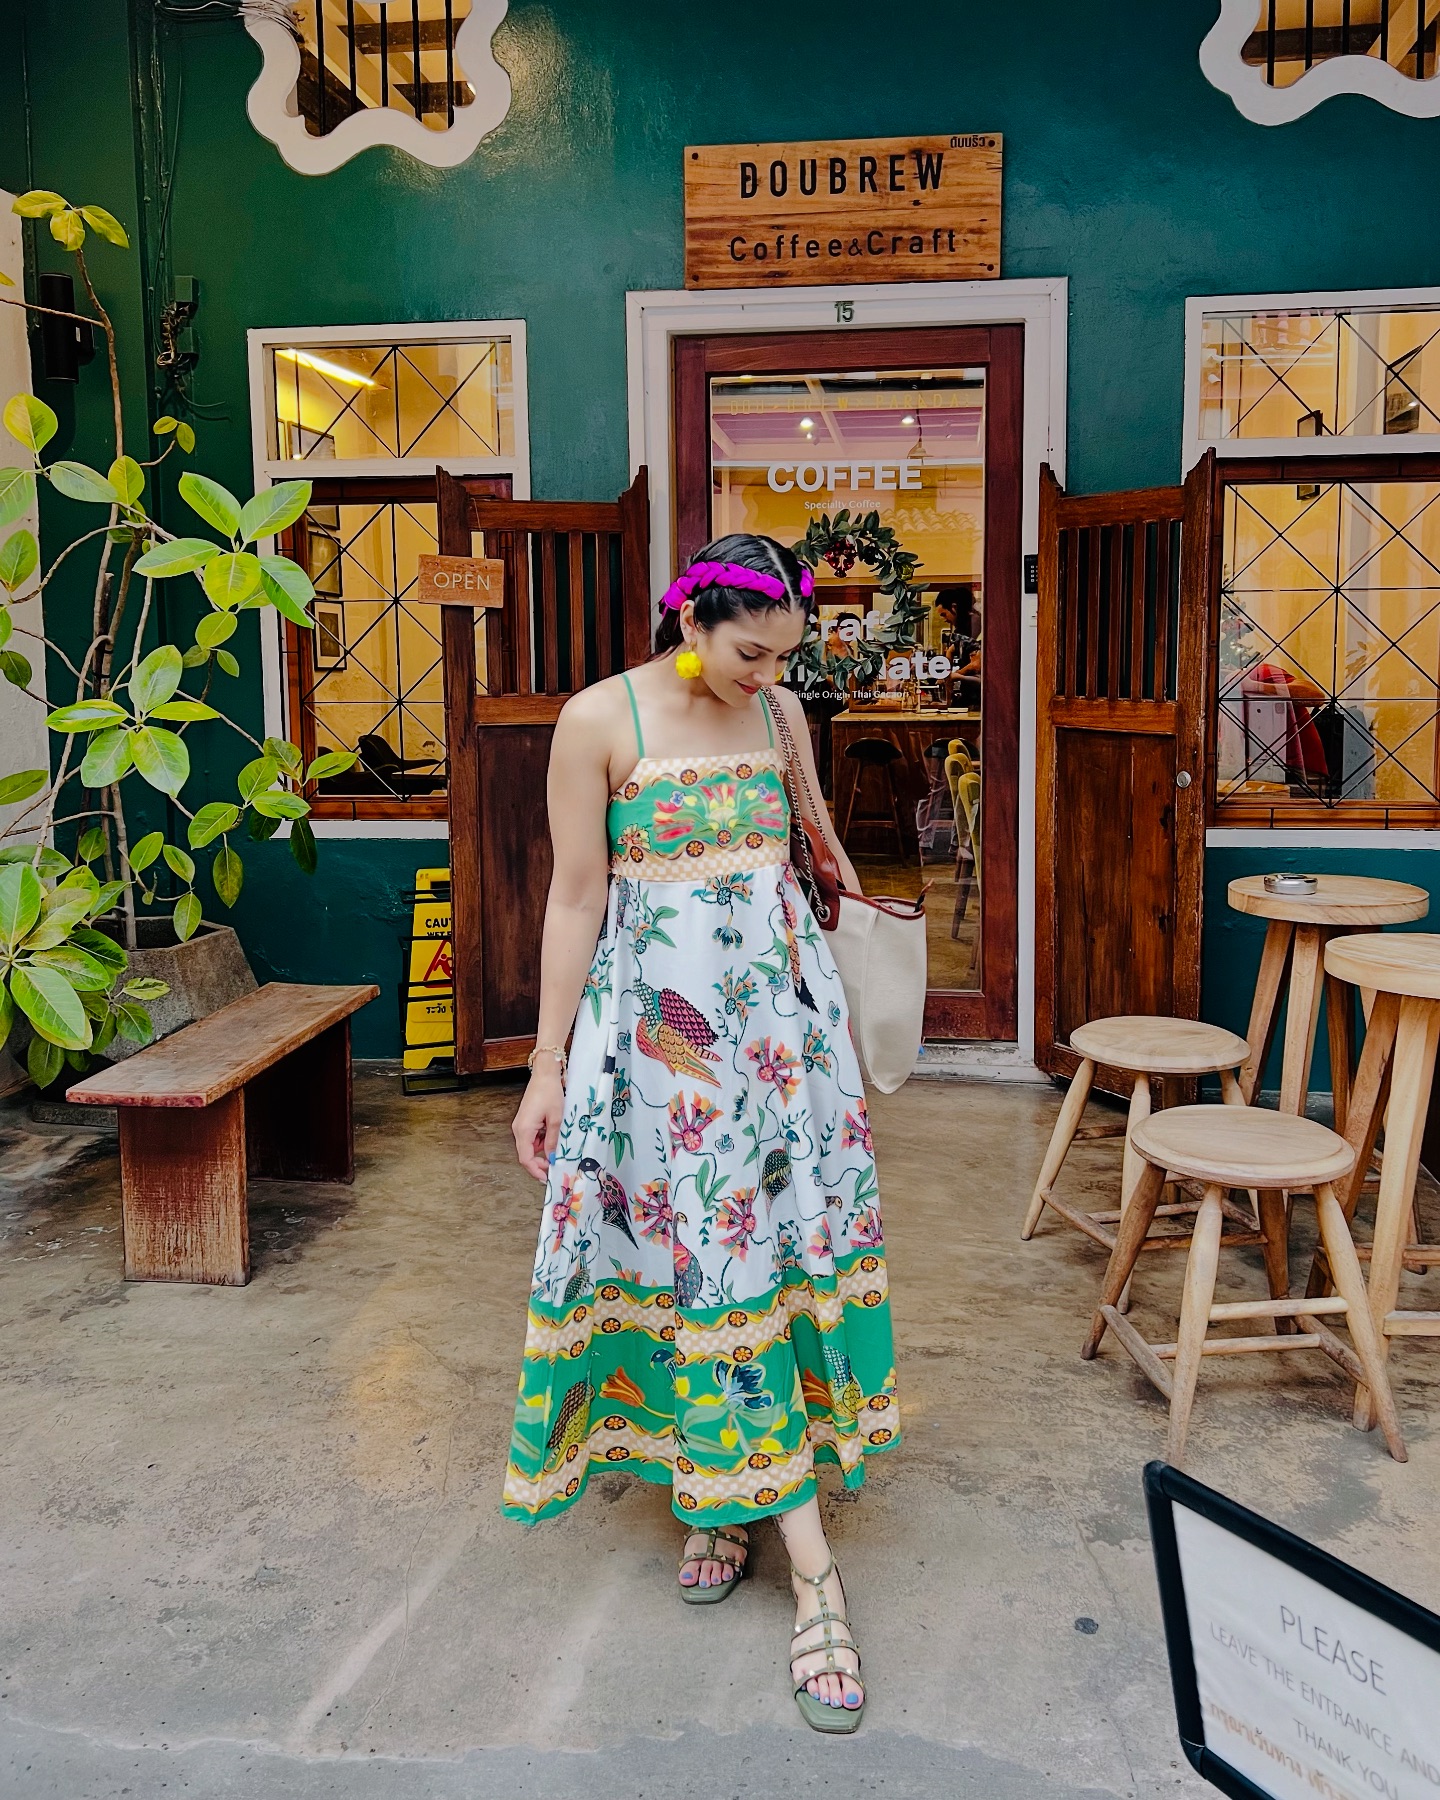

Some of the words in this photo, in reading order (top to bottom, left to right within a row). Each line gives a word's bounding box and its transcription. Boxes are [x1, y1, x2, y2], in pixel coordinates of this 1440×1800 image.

[740, 153, 944, 198] DOUBREW
[834, 300, 855, 323] 15
[767, 459, 923, 494] COFFEE
[804, 500, 847, 511] Specialty
[848, 499, 881, 509] Coffee
[433, 571, 491, 591] OPEN
[852, 689, 872, 700] Thai
[1279, 1604, 1388, 1697] PLEASE
[1209, 1620, 1258, 1668] LEAVE
[1263, 1654, 1296, 1692] THE
[1300, 1680, 1394, 1758] ENTRANCE
[1400, 1747, 1440, 1788] AND
[1293, 1716, 1354, 1773] THANK
[1358, 1760, 1399, 1800] YOU
